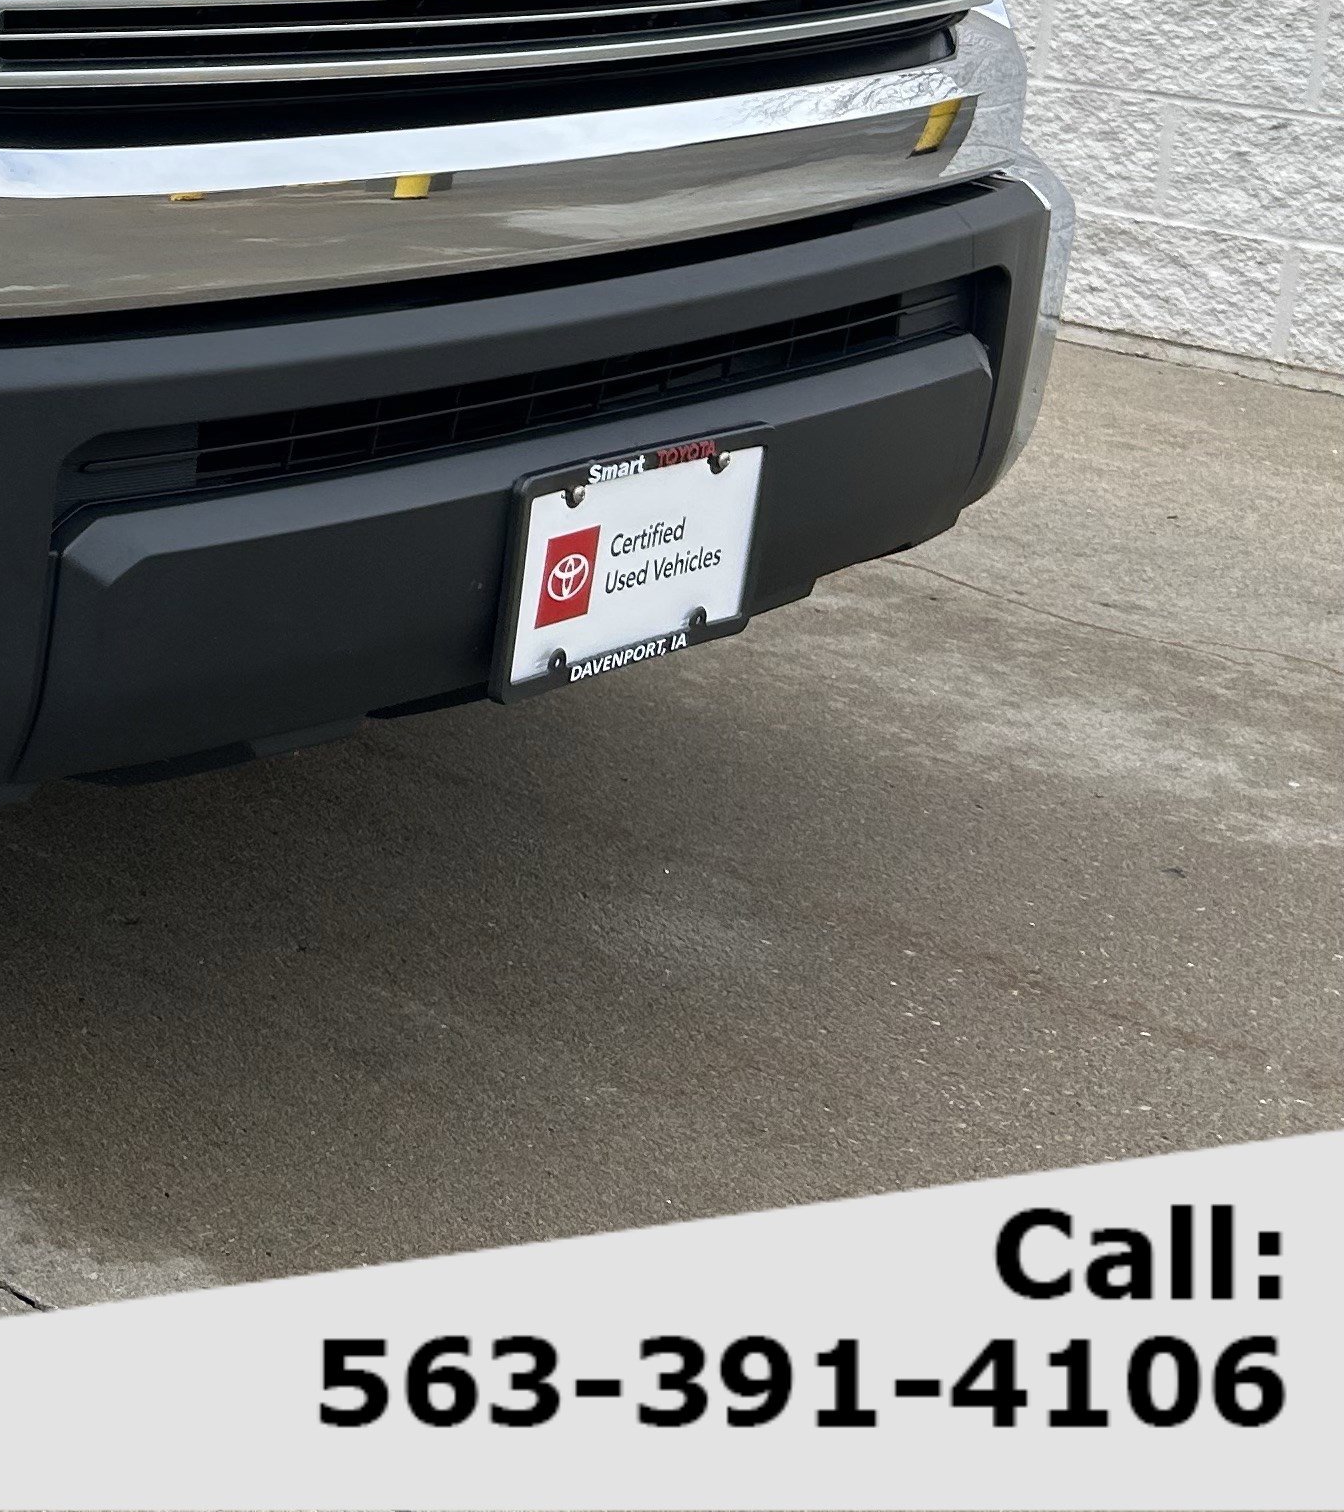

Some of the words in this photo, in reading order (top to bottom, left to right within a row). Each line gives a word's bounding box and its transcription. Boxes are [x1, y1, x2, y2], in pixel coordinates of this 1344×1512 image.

[587, 453, 646, 485] Smart
[656, 440, 716, 468] TOYOTA
[610, 515, 687, 557] Certified
[604, 560, 648, 595] Used
[653, 546, 722, 581] Vehicles
[569, 638, 667, 683] DAVENPORT,
[670, 633, 688, 649] IA
